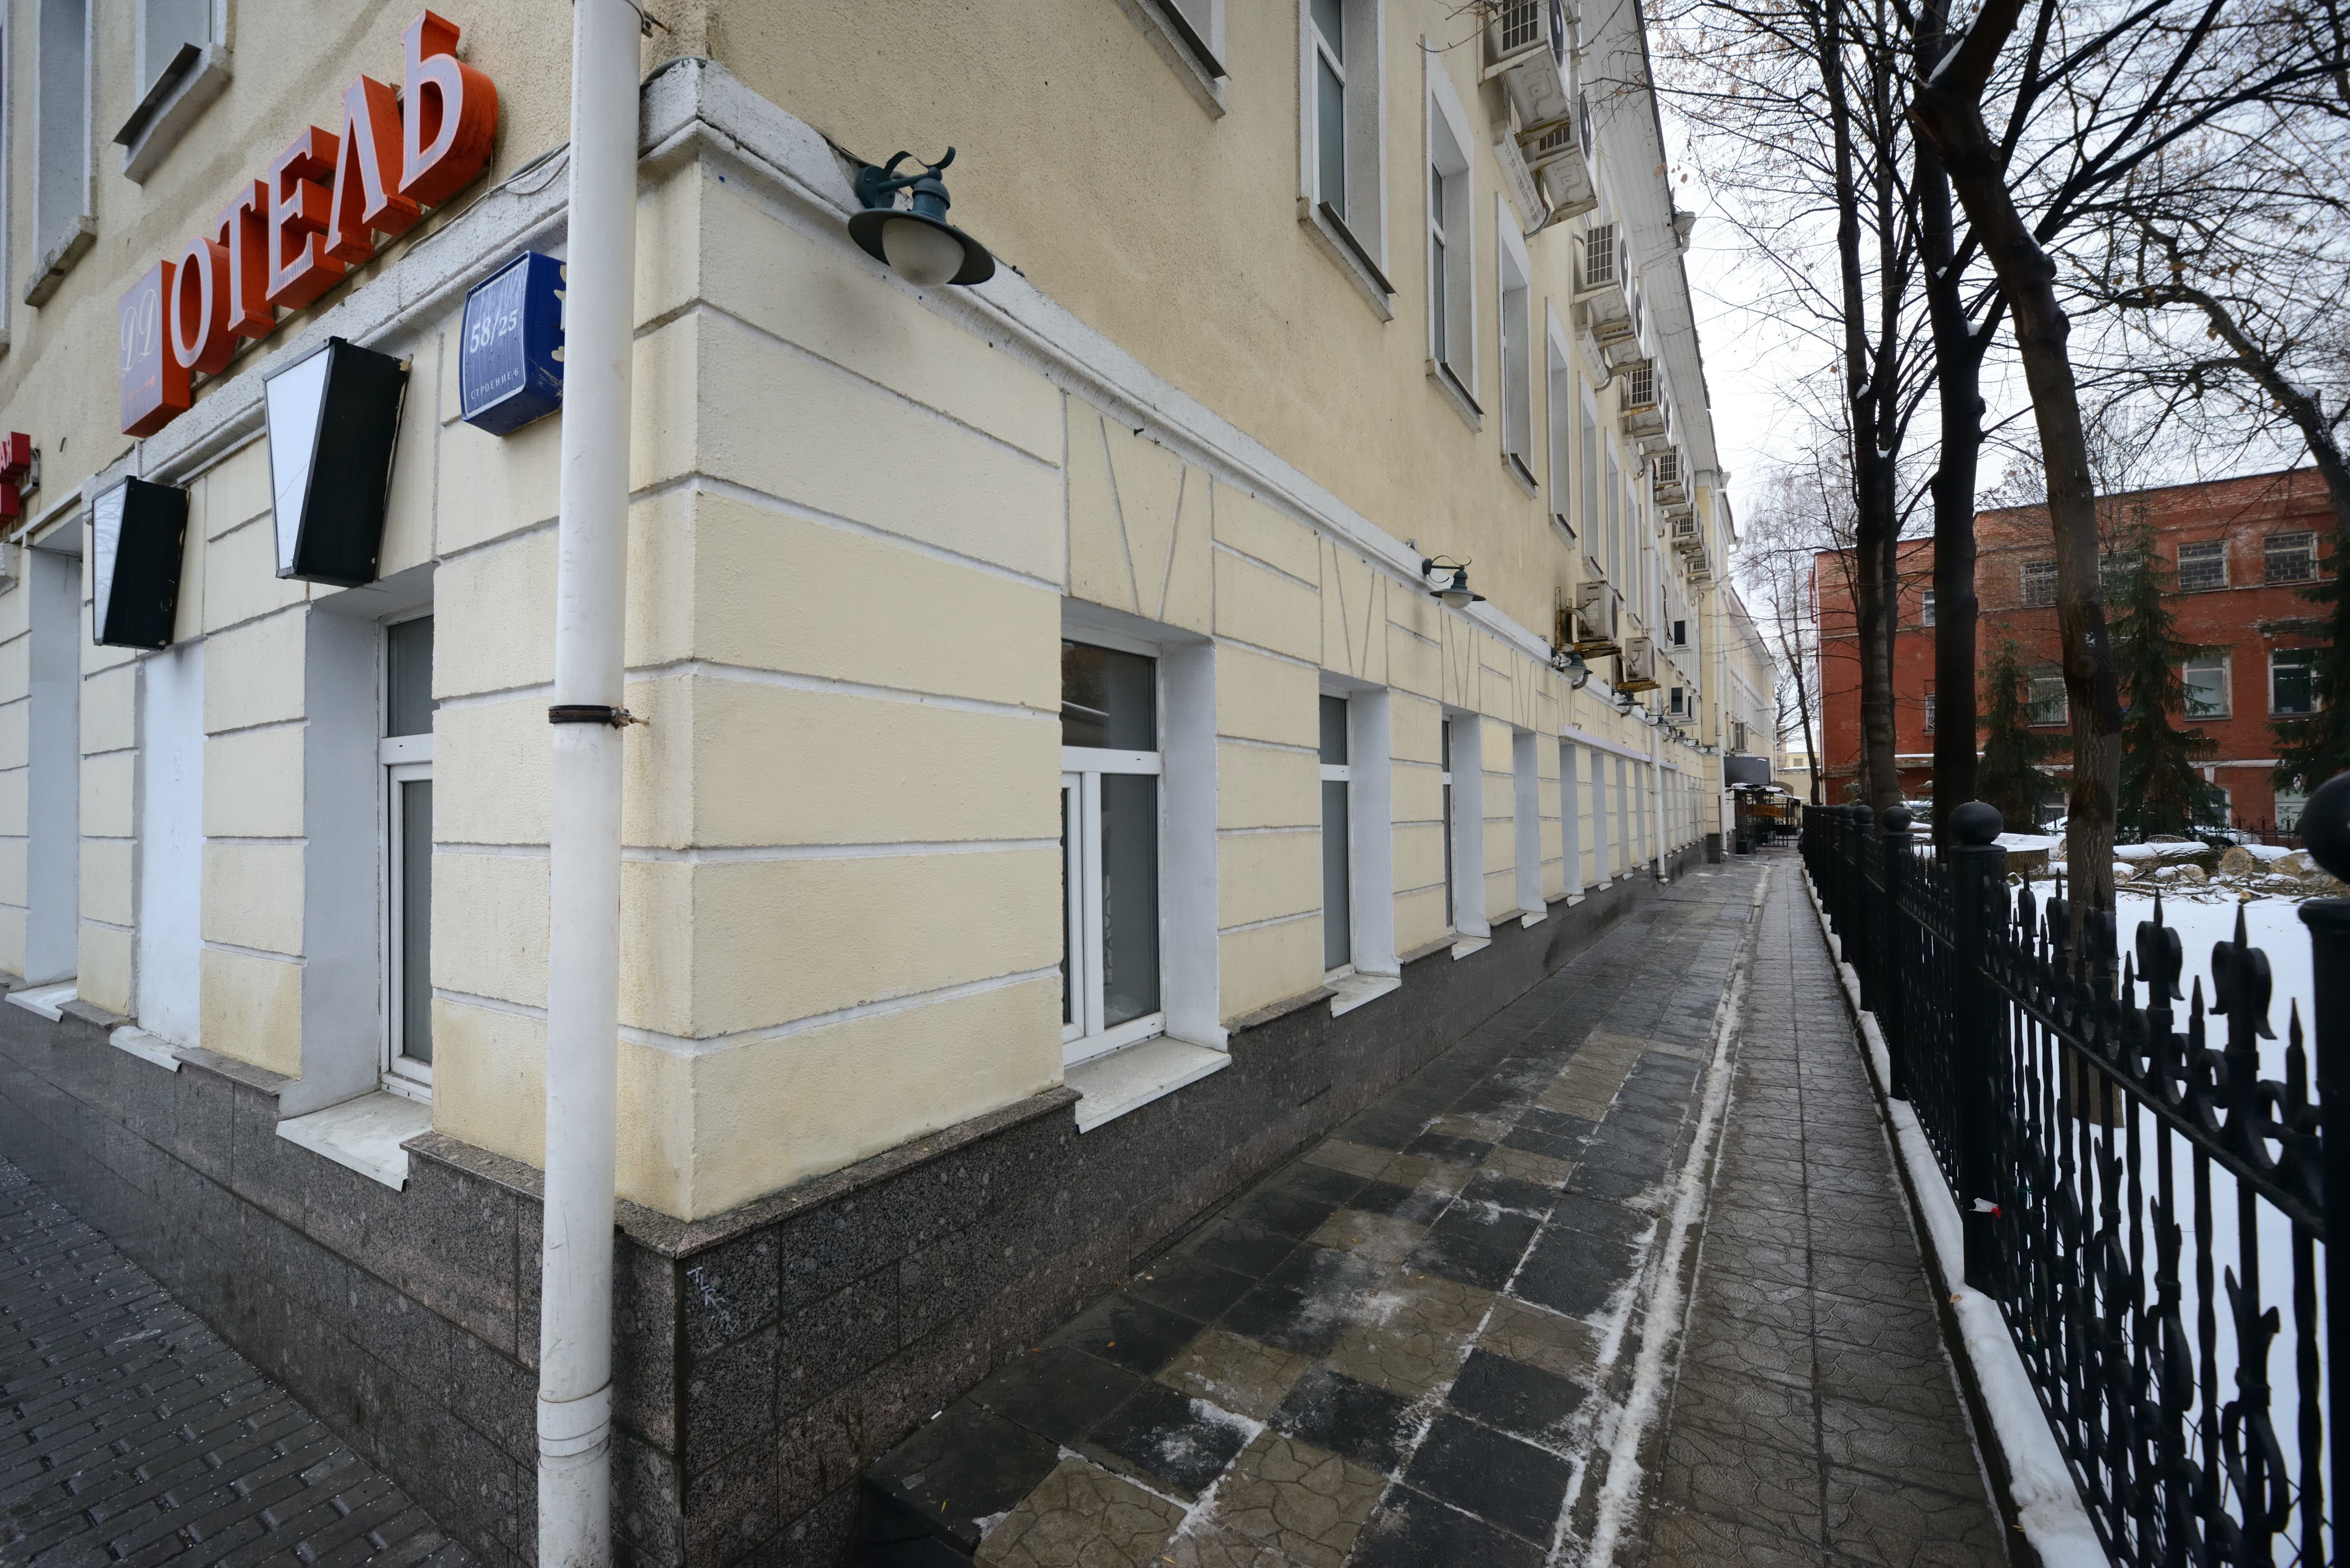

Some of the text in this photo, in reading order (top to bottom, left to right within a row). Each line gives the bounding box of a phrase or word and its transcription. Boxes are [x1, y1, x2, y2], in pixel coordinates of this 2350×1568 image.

[170, 9, 463, 368] ОТЕЛЬ
[470, 309, 518, 354] 58/25
[471, 367, 519, 400] СТРОЕНИЕ 6
